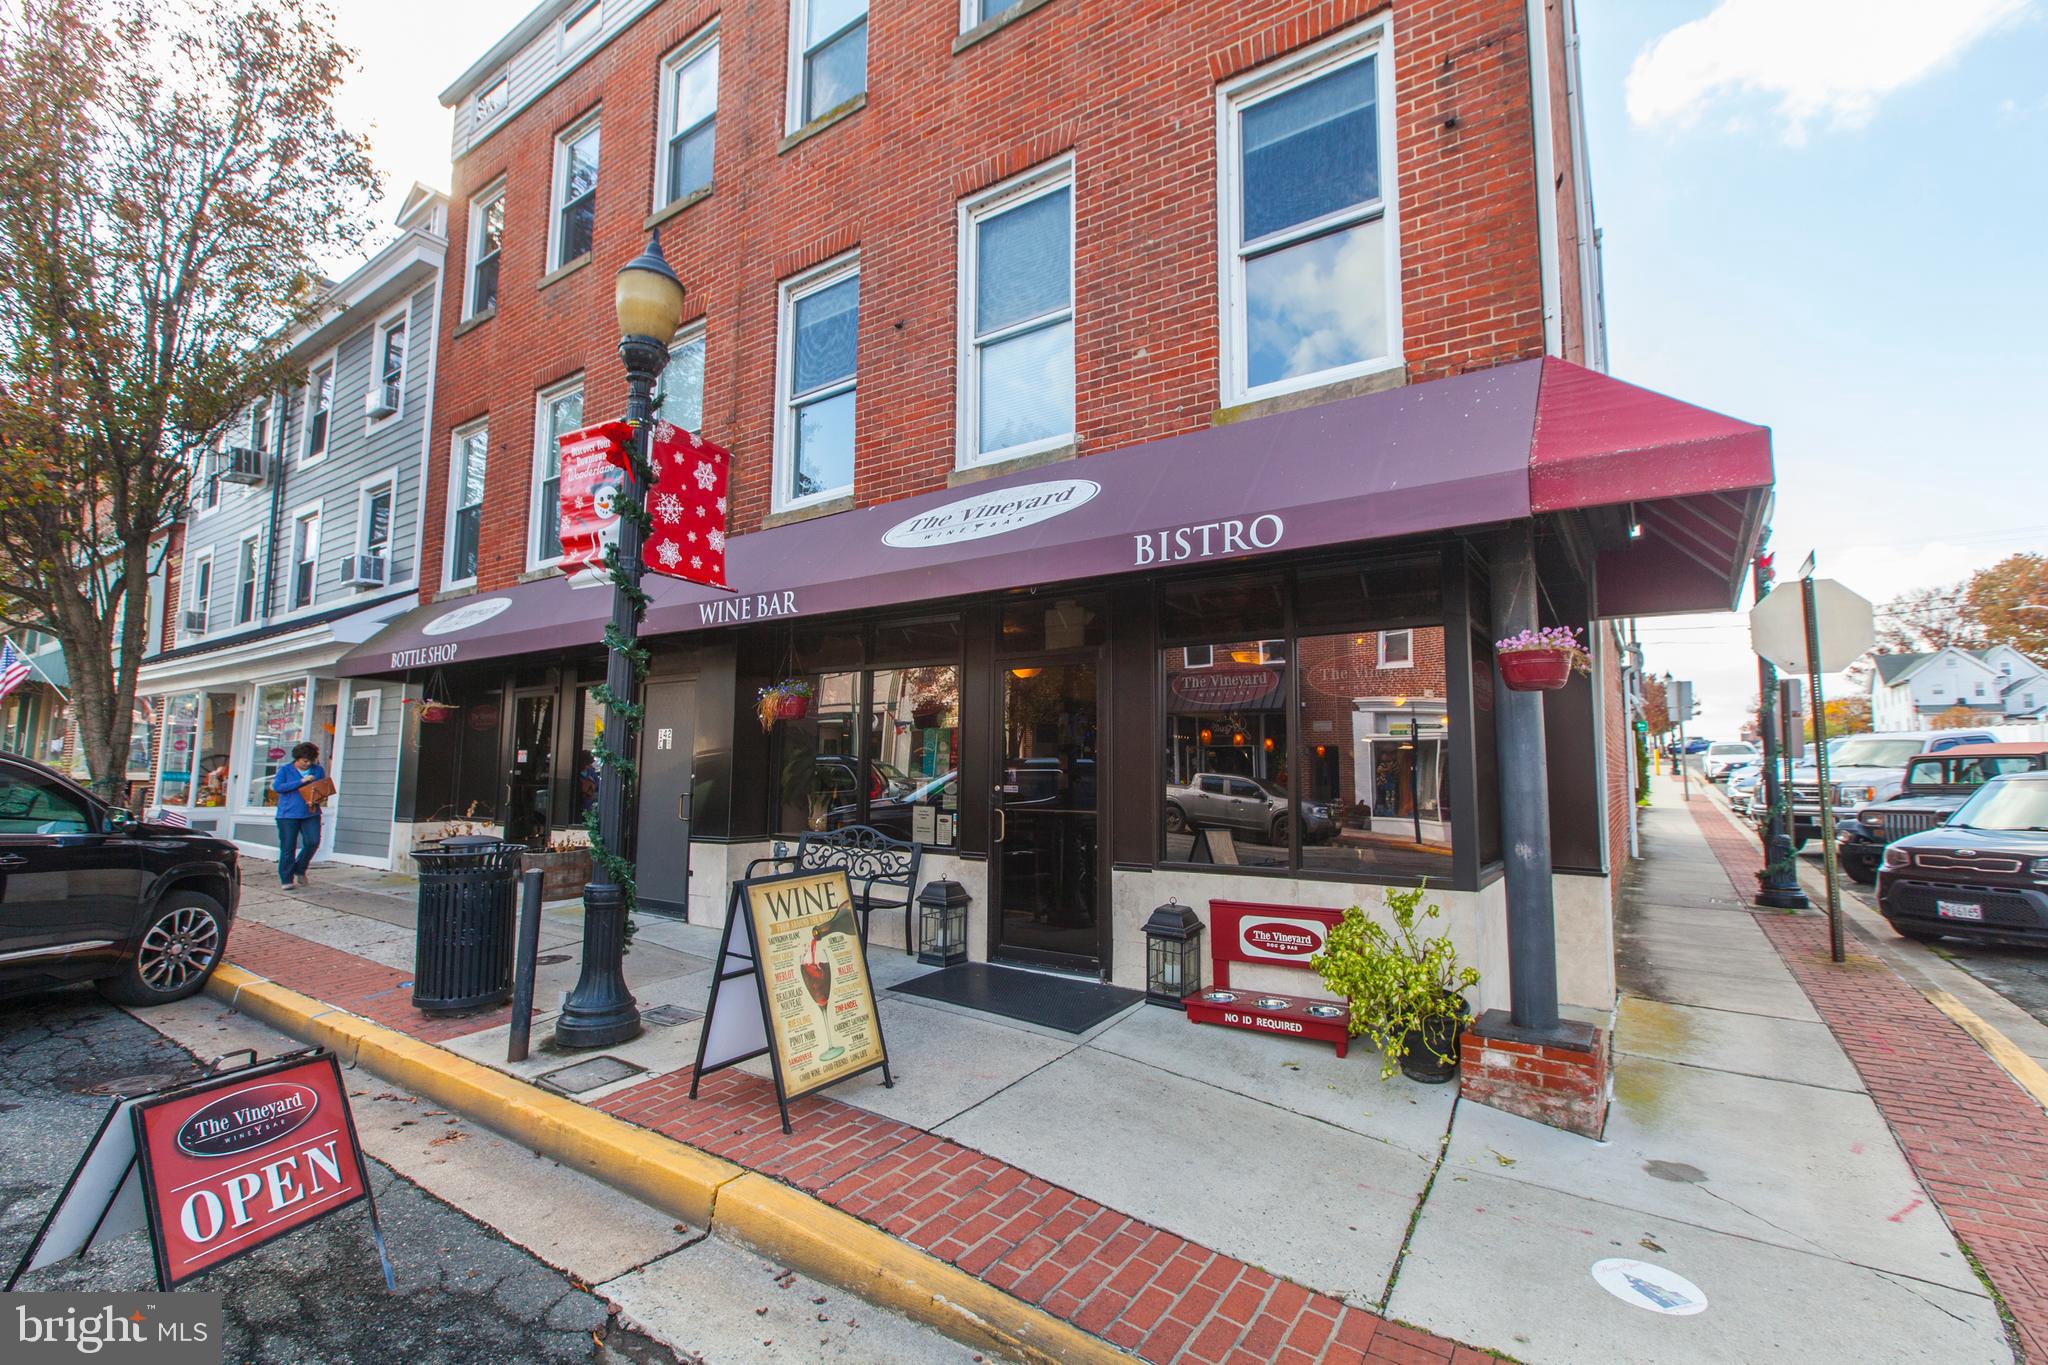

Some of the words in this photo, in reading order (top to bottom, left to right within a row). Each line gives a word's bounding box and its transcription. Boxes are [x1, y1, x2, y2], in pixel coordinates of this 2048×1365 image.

[907, 516, 952, 532] The
[961, 486, 1076, 517] Vineyard
[924, 528, 966, 540] WINE
[990, 516, 1025, 528] BAR
[1133, 514, 1284, 566] BISTRO
[699, 597, 751, 625] WINE
[757, 590, 798, 618] BAR
[391, 648, 427, 669] BOTTLE
[428, 643, 458, 664] SHOP
[1182, 676, 1207, 689] The
[1210, 672, 1268, 689] Vineyard
[764, 881, 839, 921] WINE
[1253, 930, 1271, 940] The
[1272, 932, 1312, 945] Vineyard
[775, 969, 795, 982] MERLOT
[835, 1000, 858, 1013] ZINFANDEL
[1224, 1013, 1239, 1023] NO
[1242, 1015, 1253, 1025] ID
[1256, 1017, 1303, 1033] REQUIRED
[789, 1034, 804, 1047] PINOT
[195, 1118, 230, 1139] The
[233, 1092, 303, 1126] Vineyard
[224, 1129, 253, 1144] WINE
[265, 1119, 287, 1131] BAR
[180, 1141, 343, 1244] OPEN
